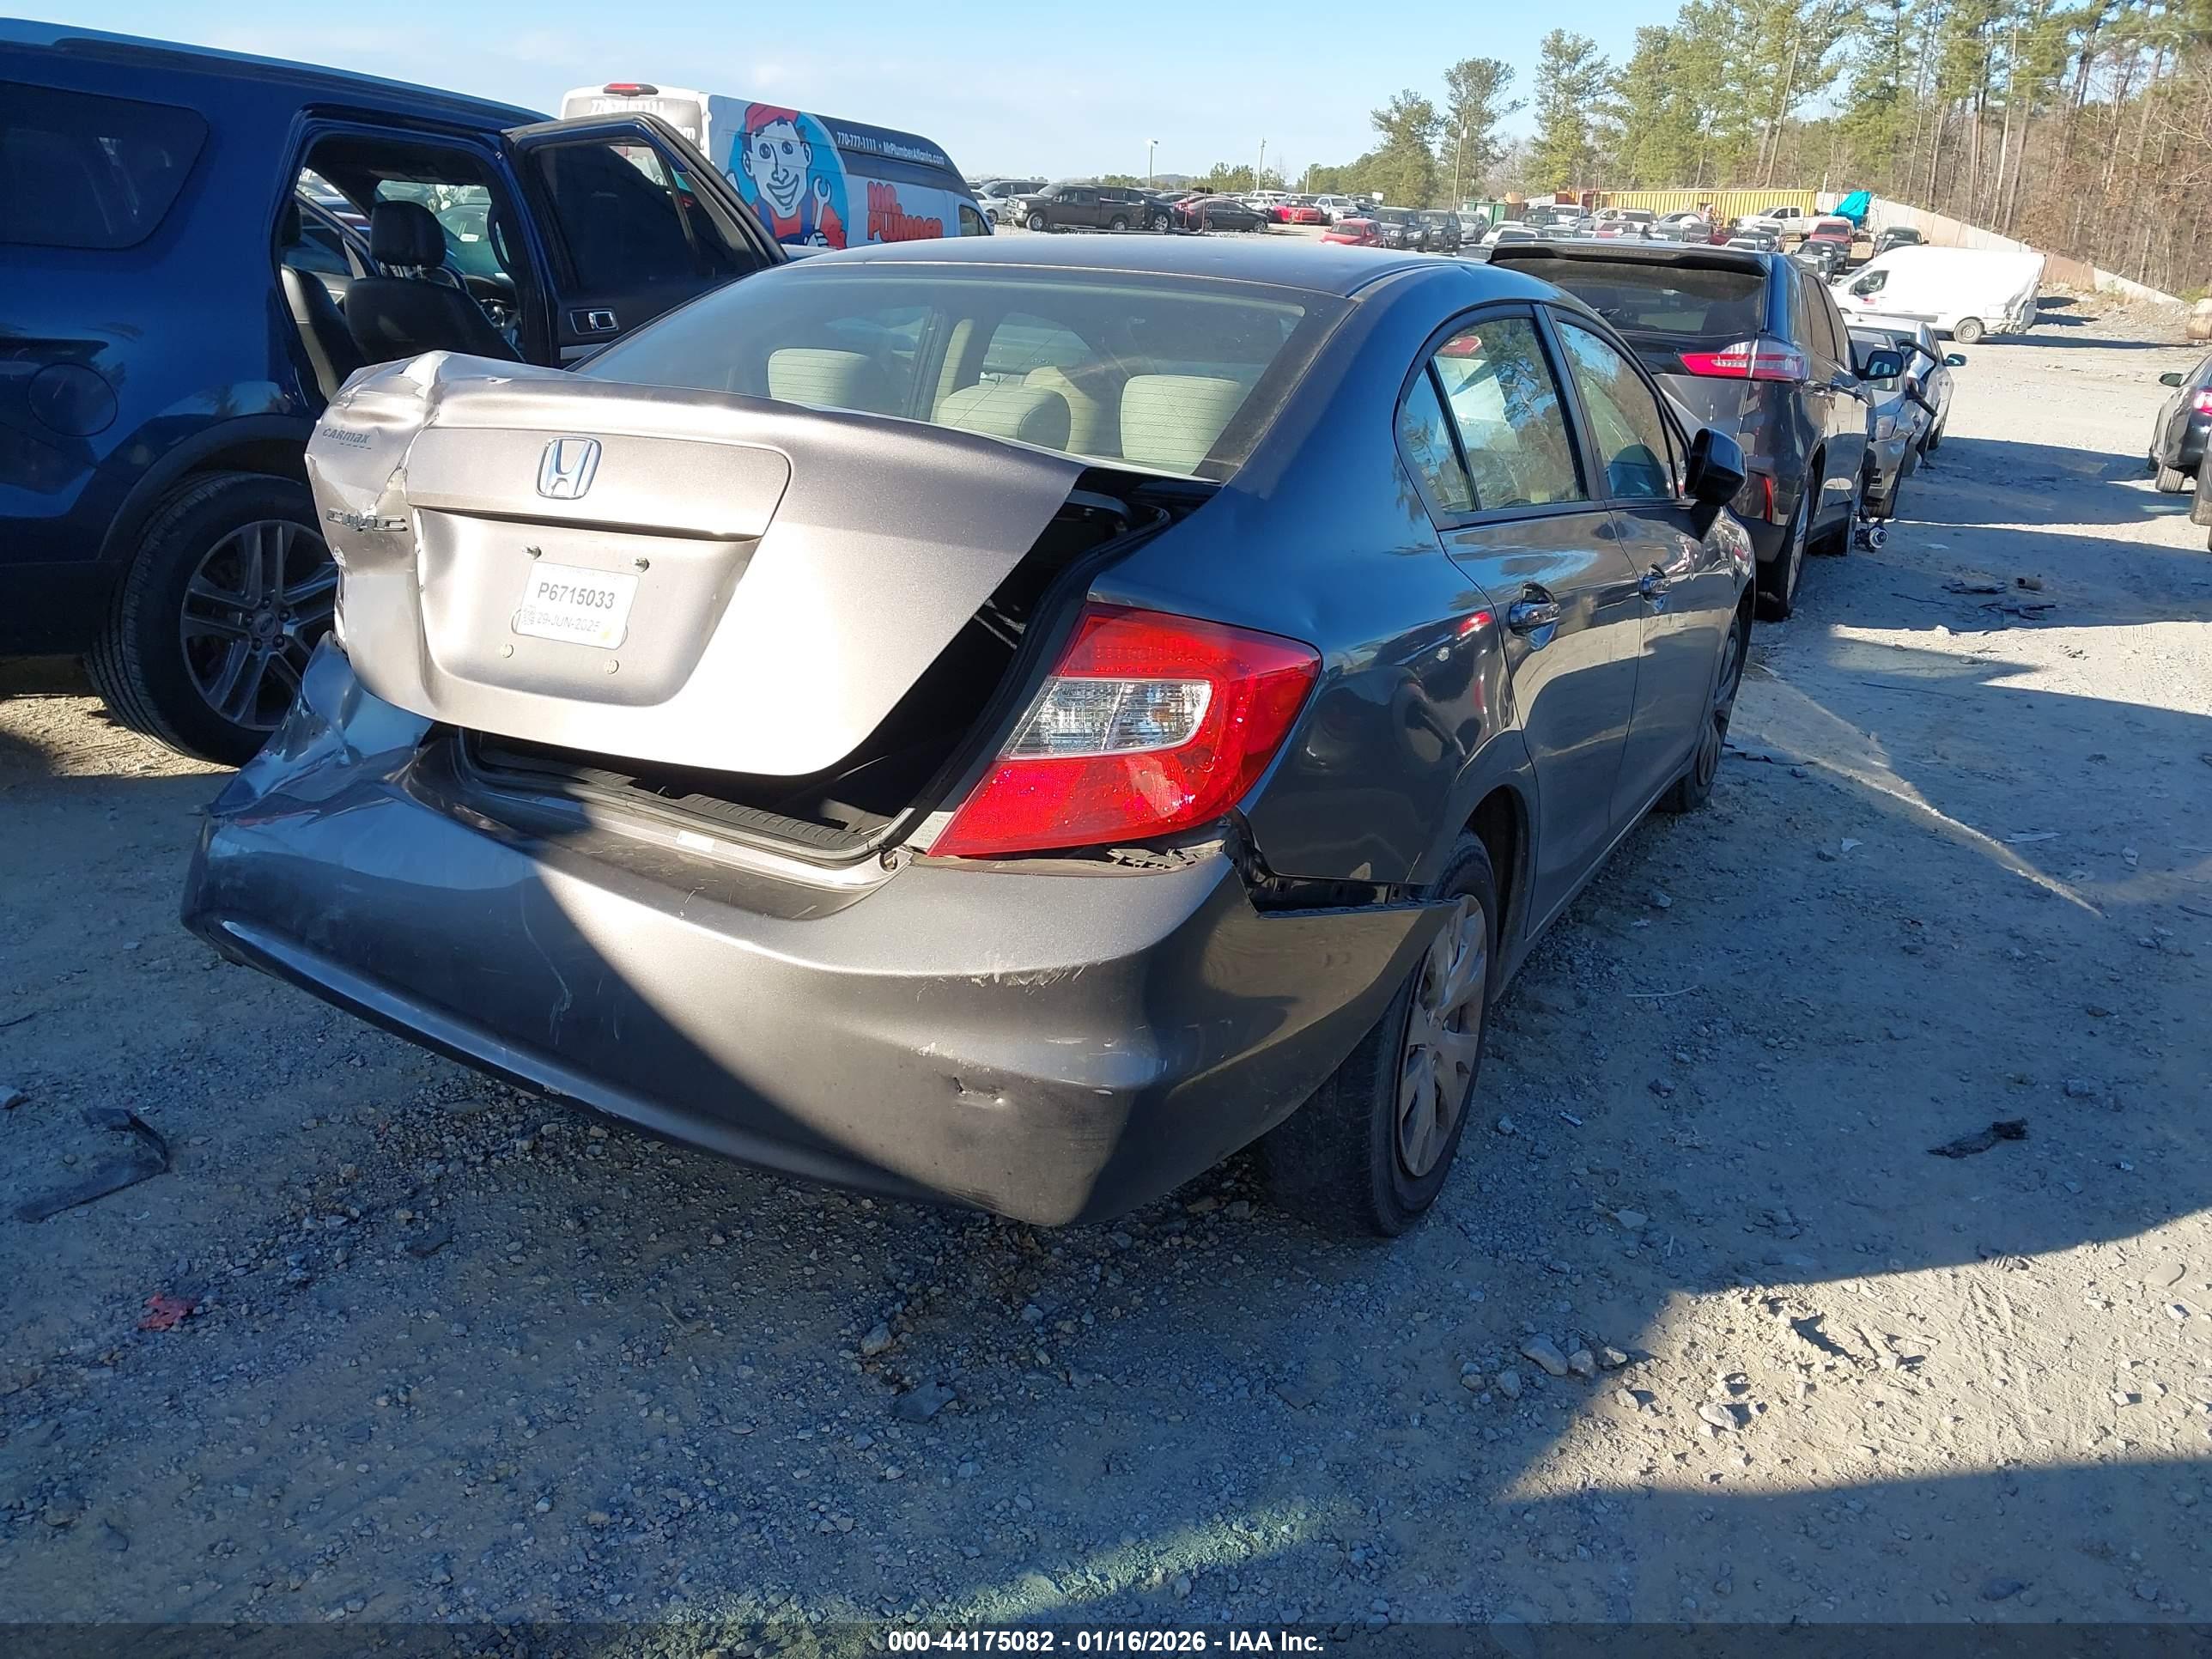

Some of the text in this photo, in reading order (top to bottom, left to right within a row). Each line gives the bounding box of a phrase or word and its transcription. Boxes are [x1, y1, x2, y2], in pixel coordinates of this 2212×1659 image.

[836, 131, 945, 166] 770-777-1111 MrPlumberAtlanta.com
[538, 581, 616, 610] P6715033
